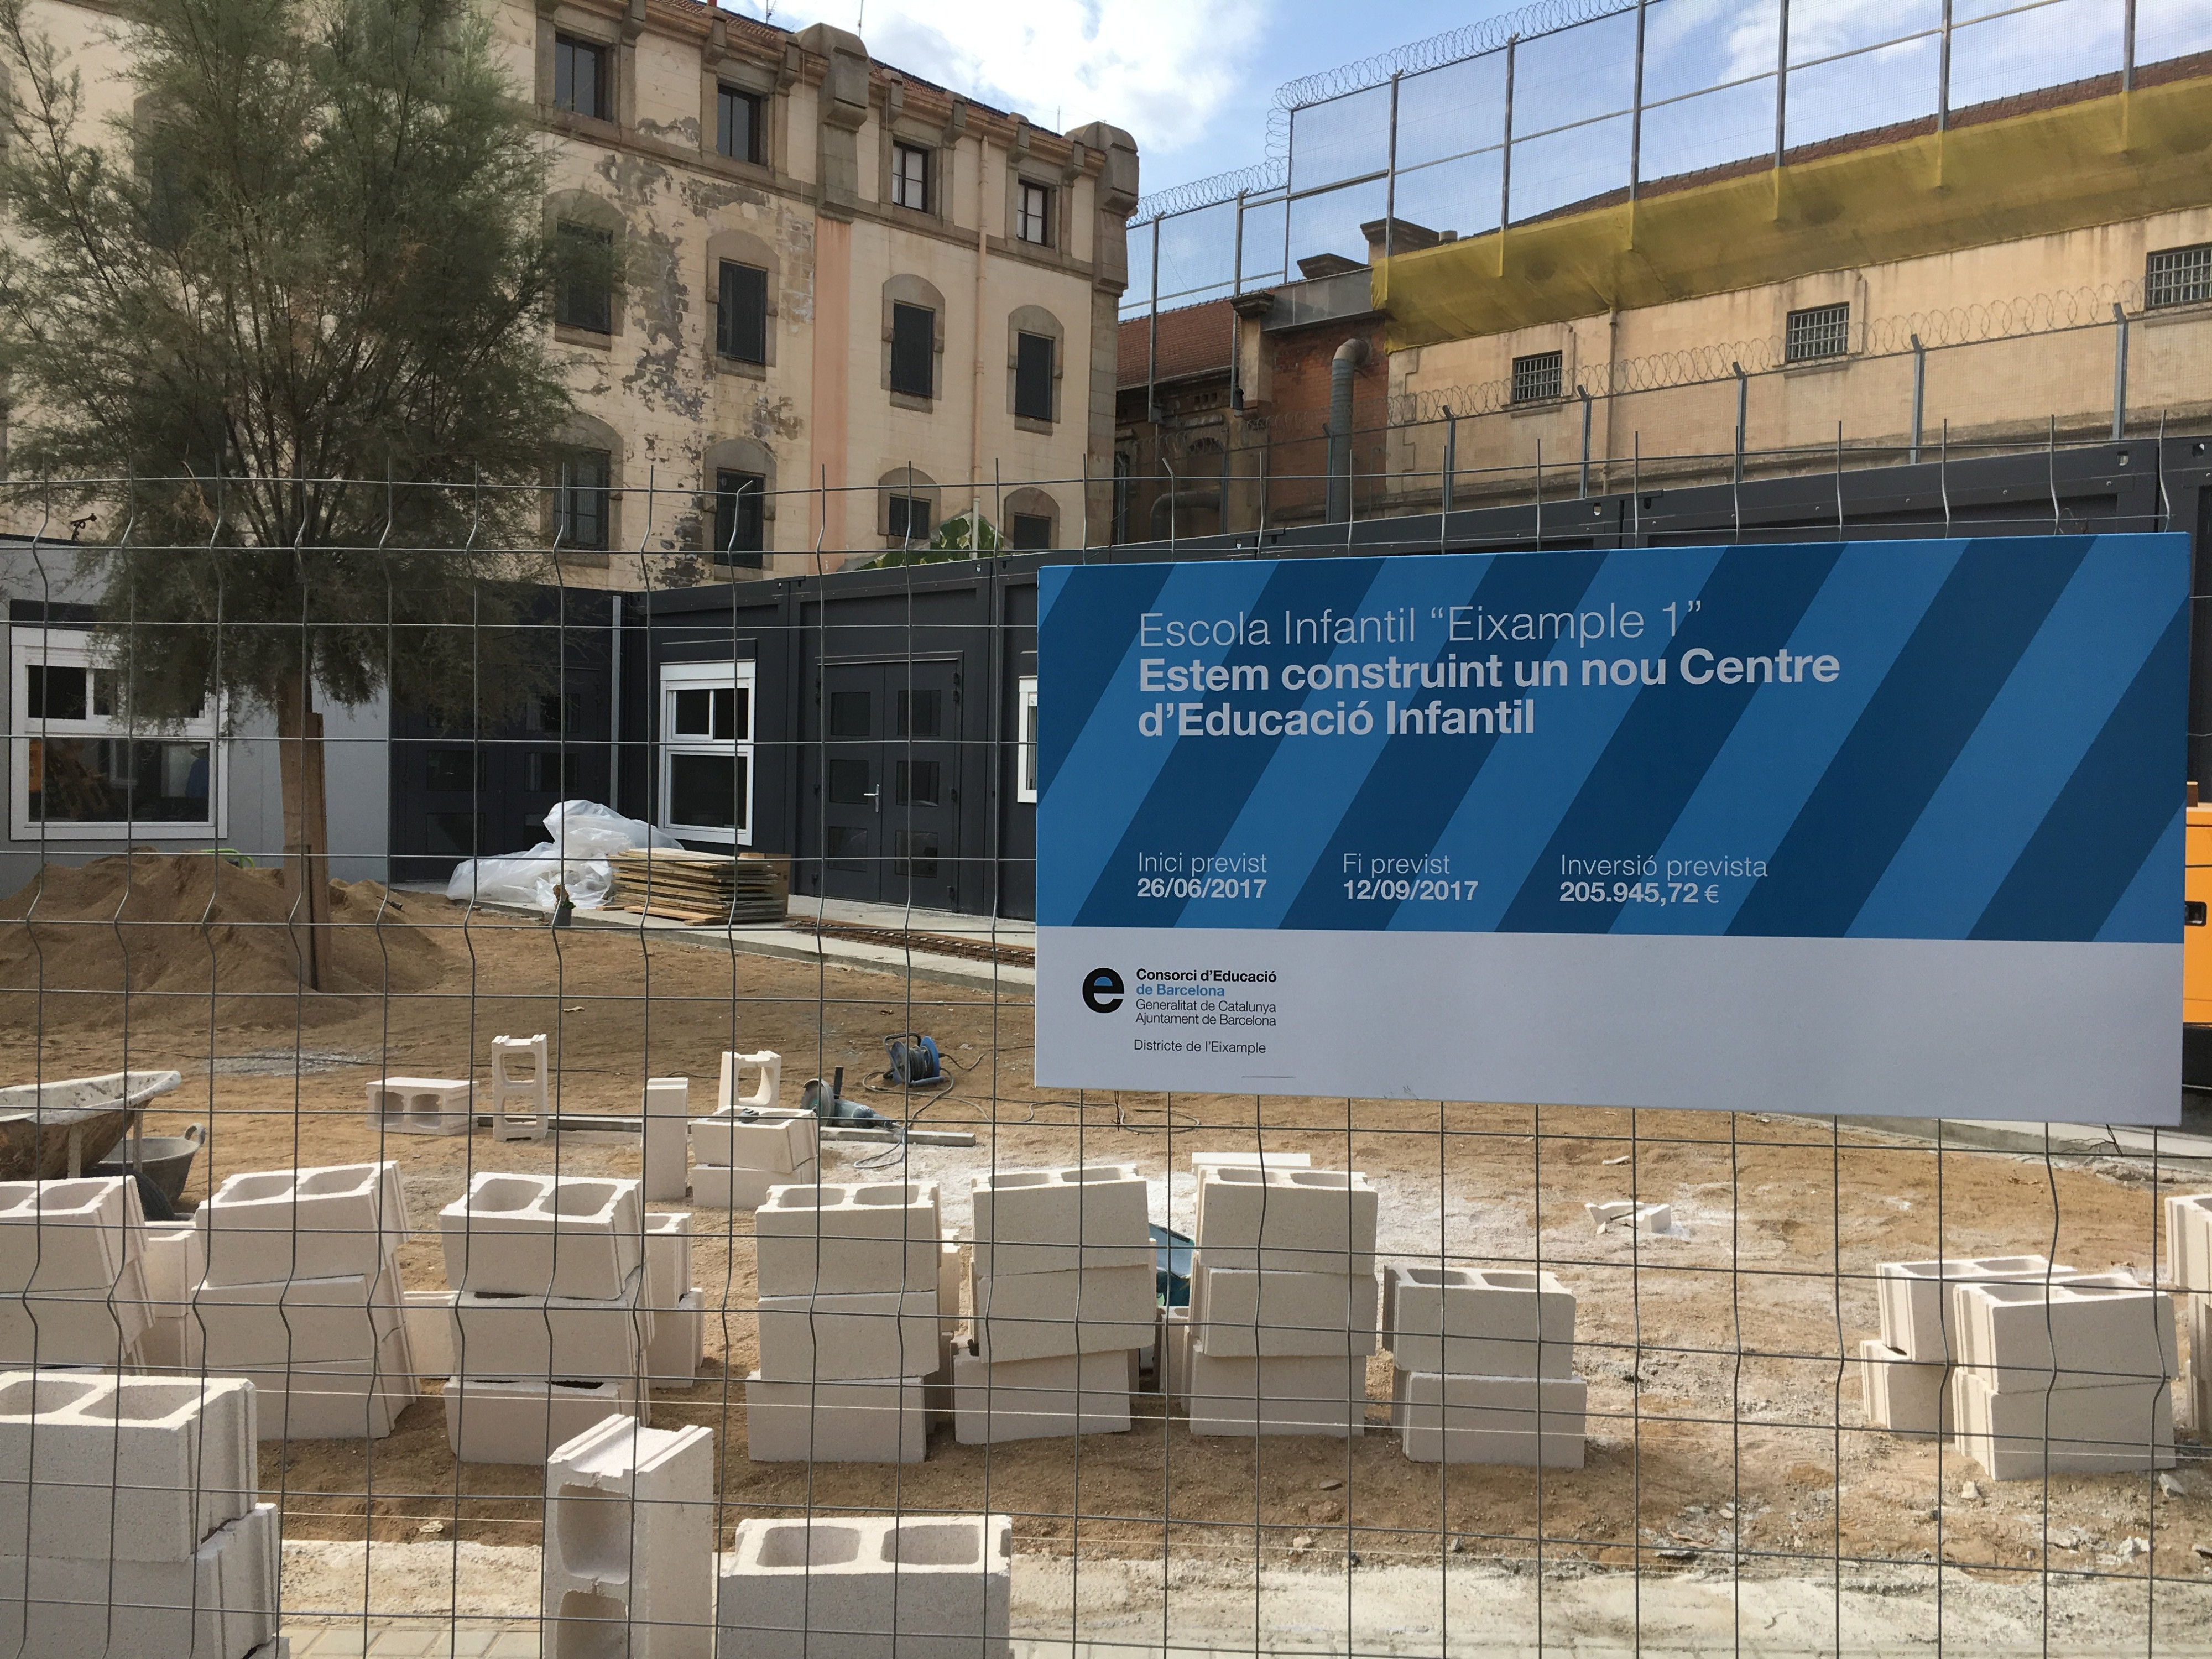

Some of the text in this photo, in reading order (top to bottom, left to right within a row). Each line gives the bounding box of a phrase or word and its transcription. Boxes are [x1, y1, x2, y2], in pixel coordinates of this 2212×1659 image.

[1141, 600, 1701, 648] Escola Infantil “Eixample 1”
[1140, 648, 1840, 692] Estem construint un nou Centre
[1138, 698, 1534, 737] d’Educació Infantil
[1139, 852, 1267, 877] Inici previst
[1344, 853, 1450, 879] Fi previst
[1562, 854, 1768, 881] Inversió prevista
[1137, 878, 1267, 898] 26/06/2017
[1343, 879, 1478, 900] 12/09/2017
[1559, 881, 1719, 907] 205.945,72 €
[1136, 968, 1277, 983] Consorci d’Educació
[1136, 983, 1225, 997] de Barcelona
[1136, 998, 1276, 1015] Generalitat de Catalunya
[1135, 1012, 1277, 1026] Ajuntament de Barcelona
[1134, 1039, 1266, 1056] Districte de l’Eixample
